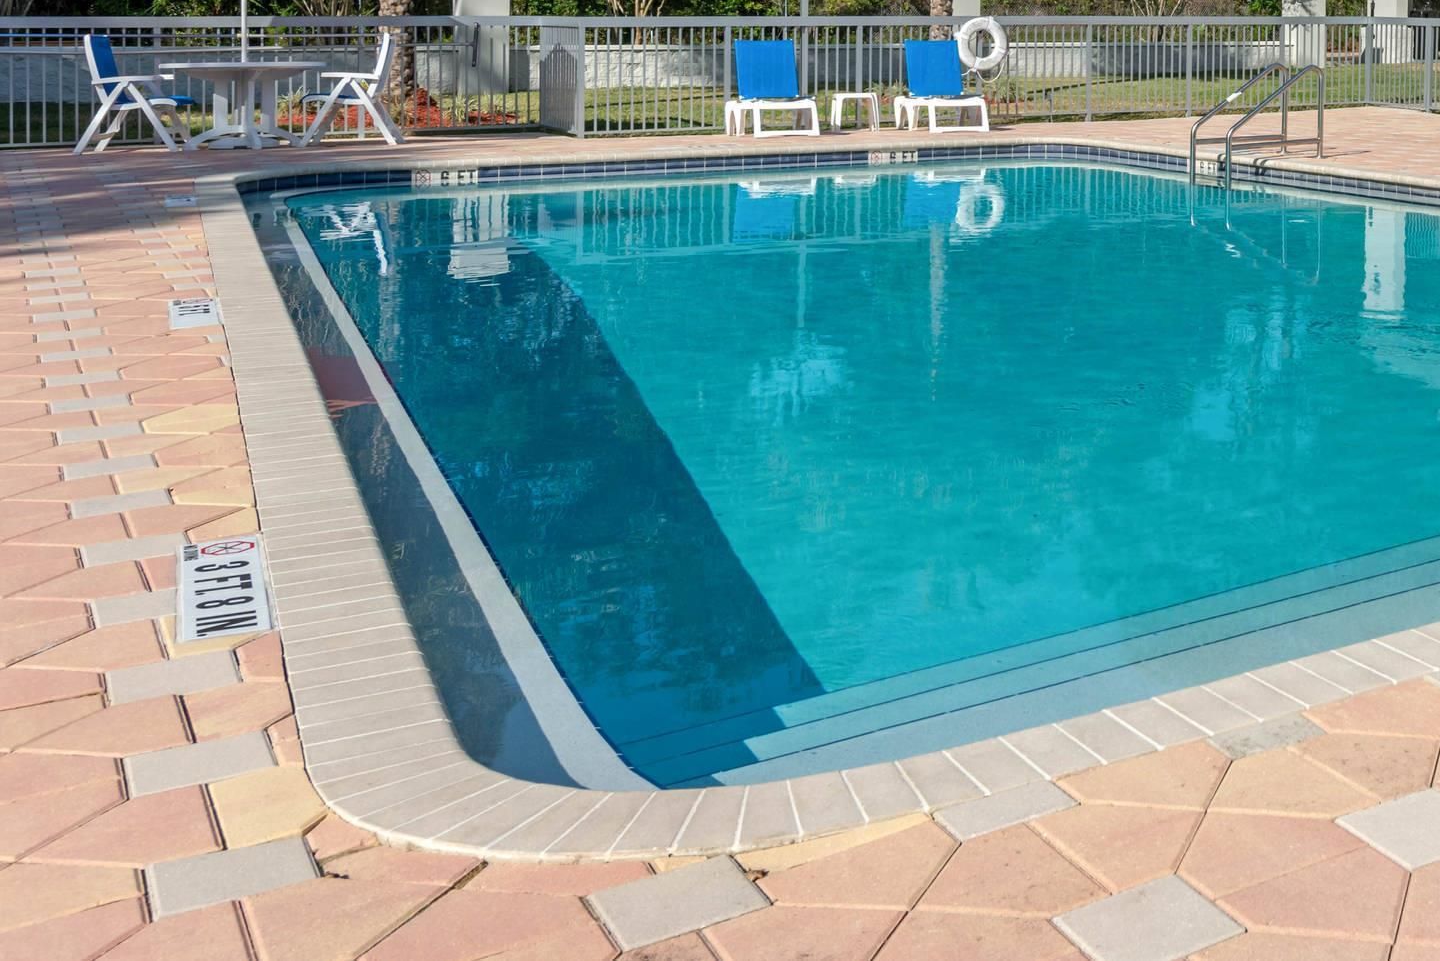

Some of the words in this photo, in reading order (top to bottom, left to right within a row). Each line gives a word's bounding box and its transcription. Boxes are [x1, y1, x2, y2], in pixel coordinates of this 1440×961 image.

[194, 560, 250, 573] 3
[194, 573, 253, 596] FT.
[195, 595, 255, 609] 8
[196, 610, 258, 637] IN.
